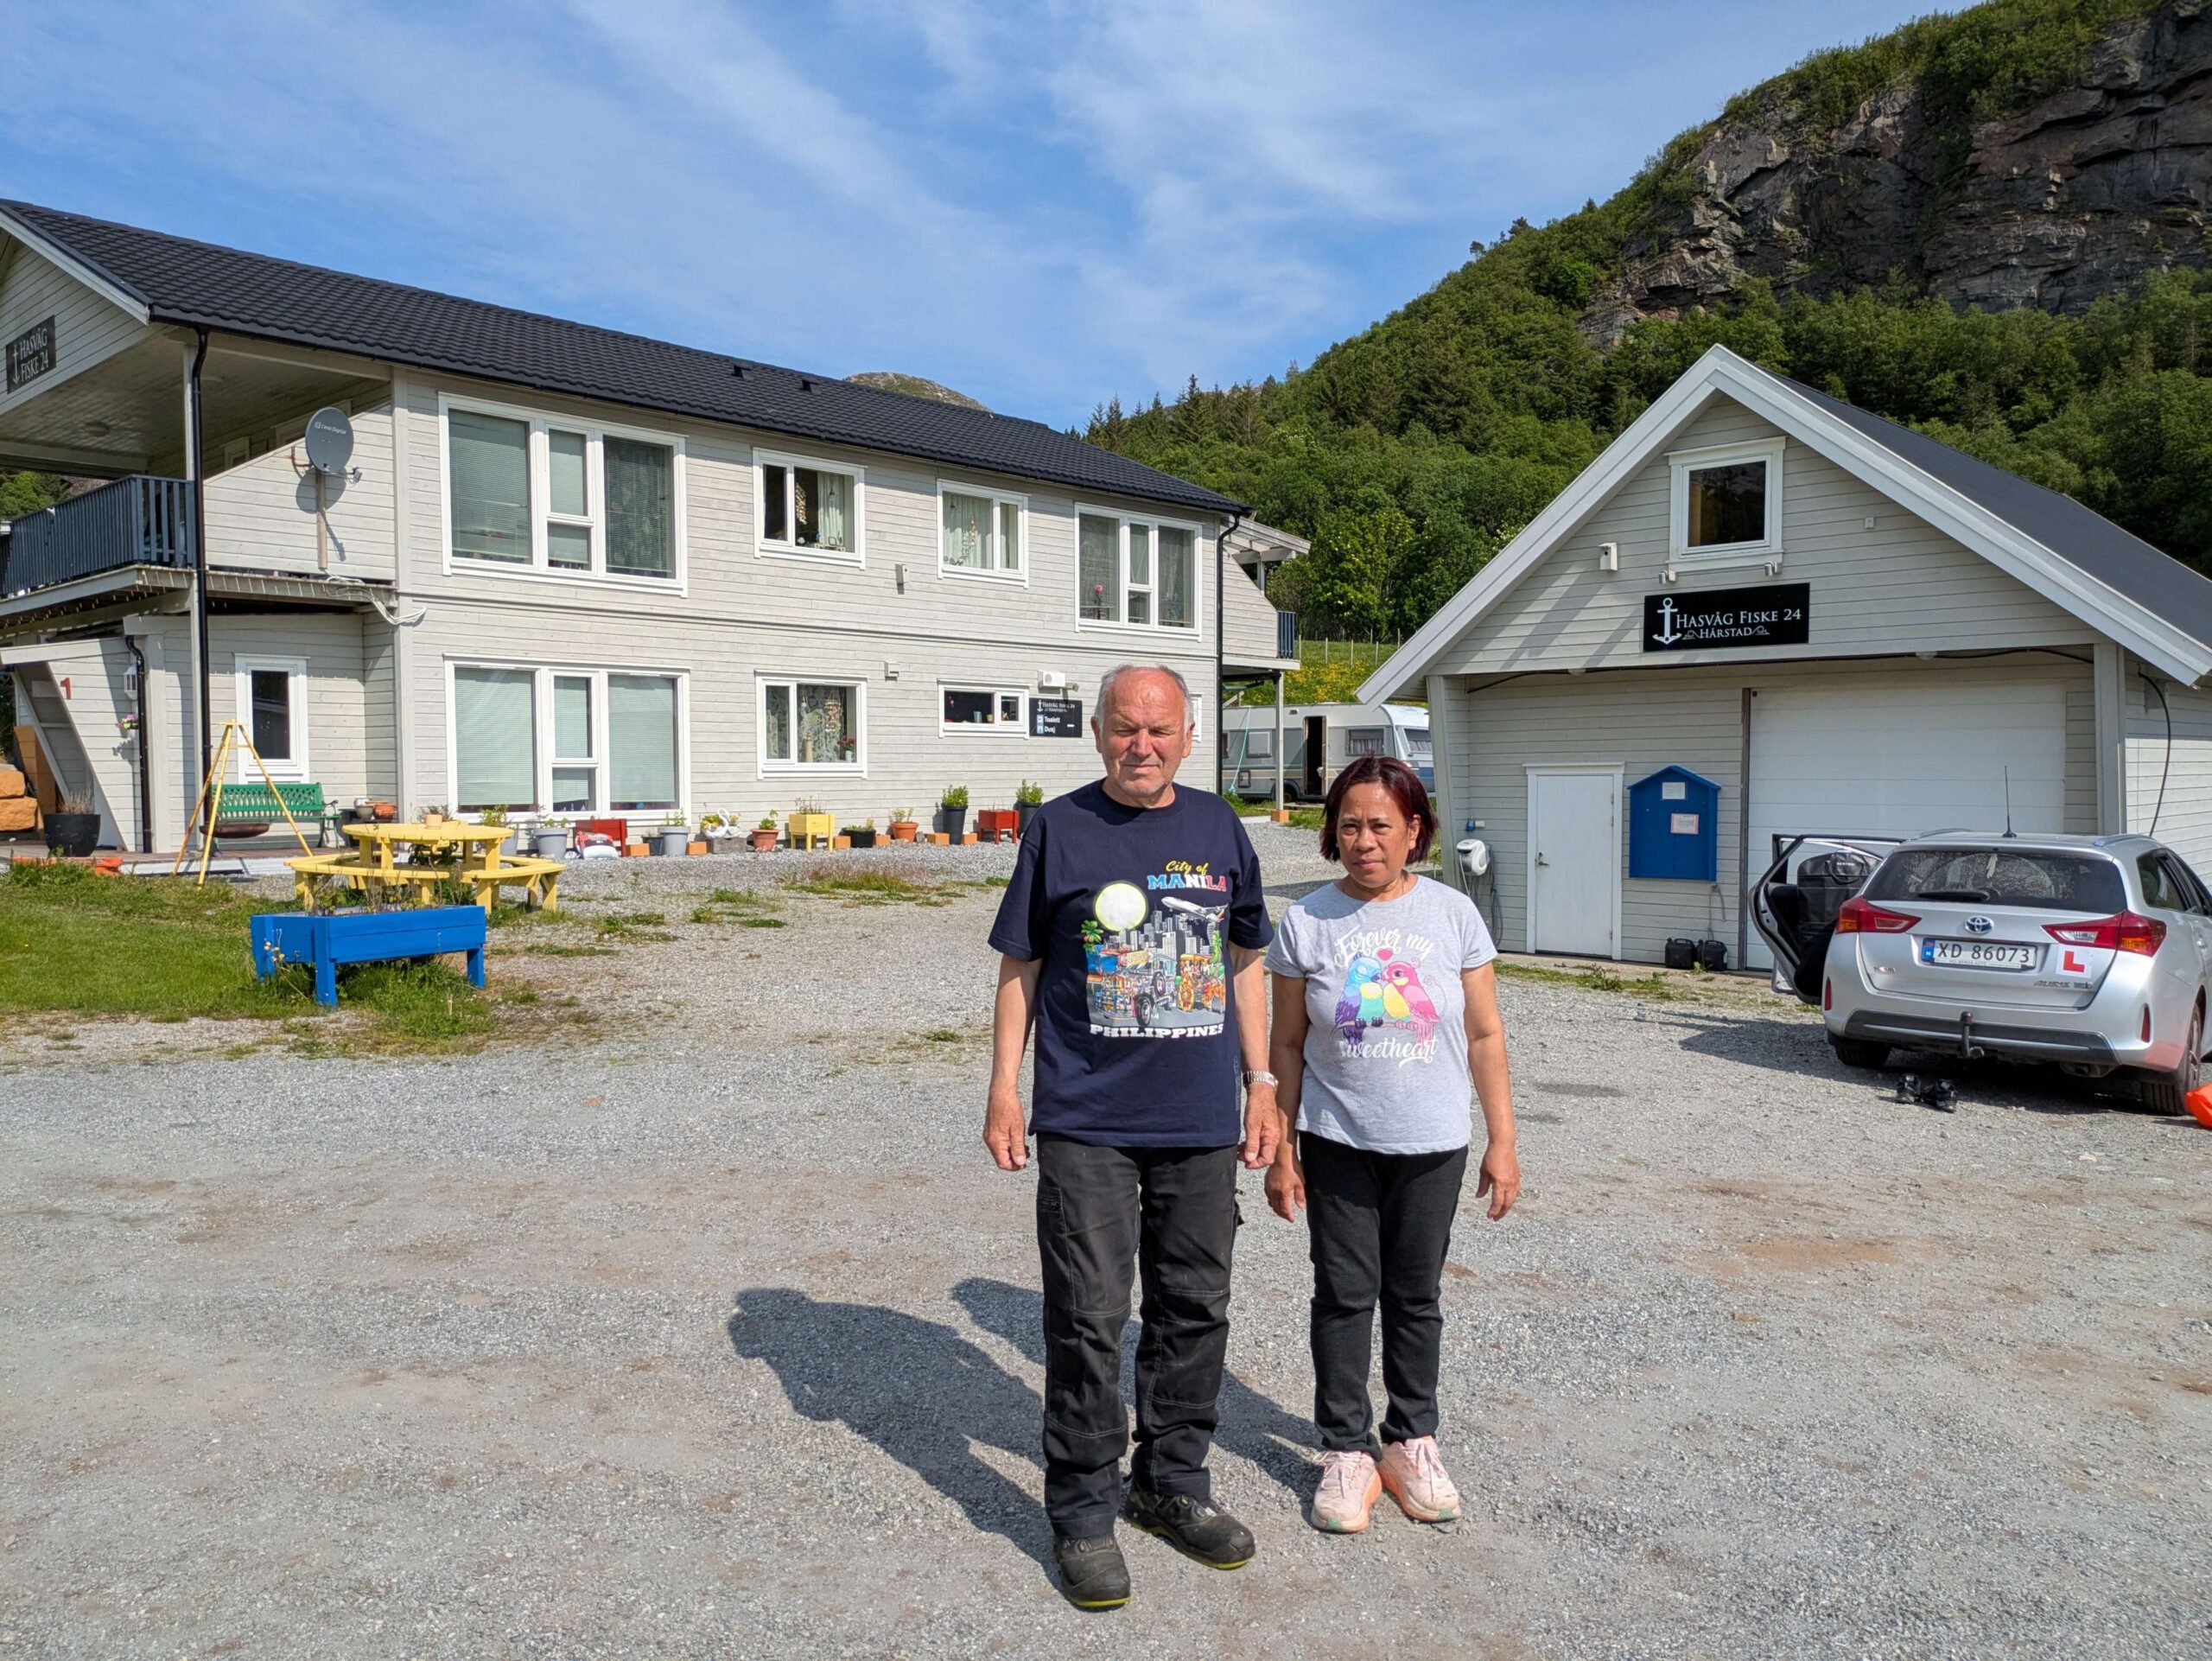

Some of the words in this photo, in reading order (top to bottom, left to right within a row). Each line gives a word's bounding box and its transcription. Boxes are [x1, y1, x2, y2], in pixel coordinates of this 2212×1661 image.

[20, 328, 48, 360] HASVÅG
[21, 356, 40, 382] FISKE
[41, 349, 48, 371] 24
[1675, 611, 1733, 628] HASVÅG
[1739, 610, 1778, 624] FISKE
[1783, 608, 1802, 620] 24
[1700, 627, 1752, 640] HÅRSTAD
[60, 677, 72, 700] 1
[1165, 860, 1192, 875] City
[1196, 862, 1209, 876] of
[1147, 874, 1227, 892] MANILA
[1334, 925, 1402, 968] Forever
[1406, 933, 1434, 963] my
[1937, 942, 1962, 958] XD
[1971, 945, 2030, 964] 86073
[2063, 950, 2085, 973] L
[1090, 1023, 1224, 1039] PHILIPPINES
